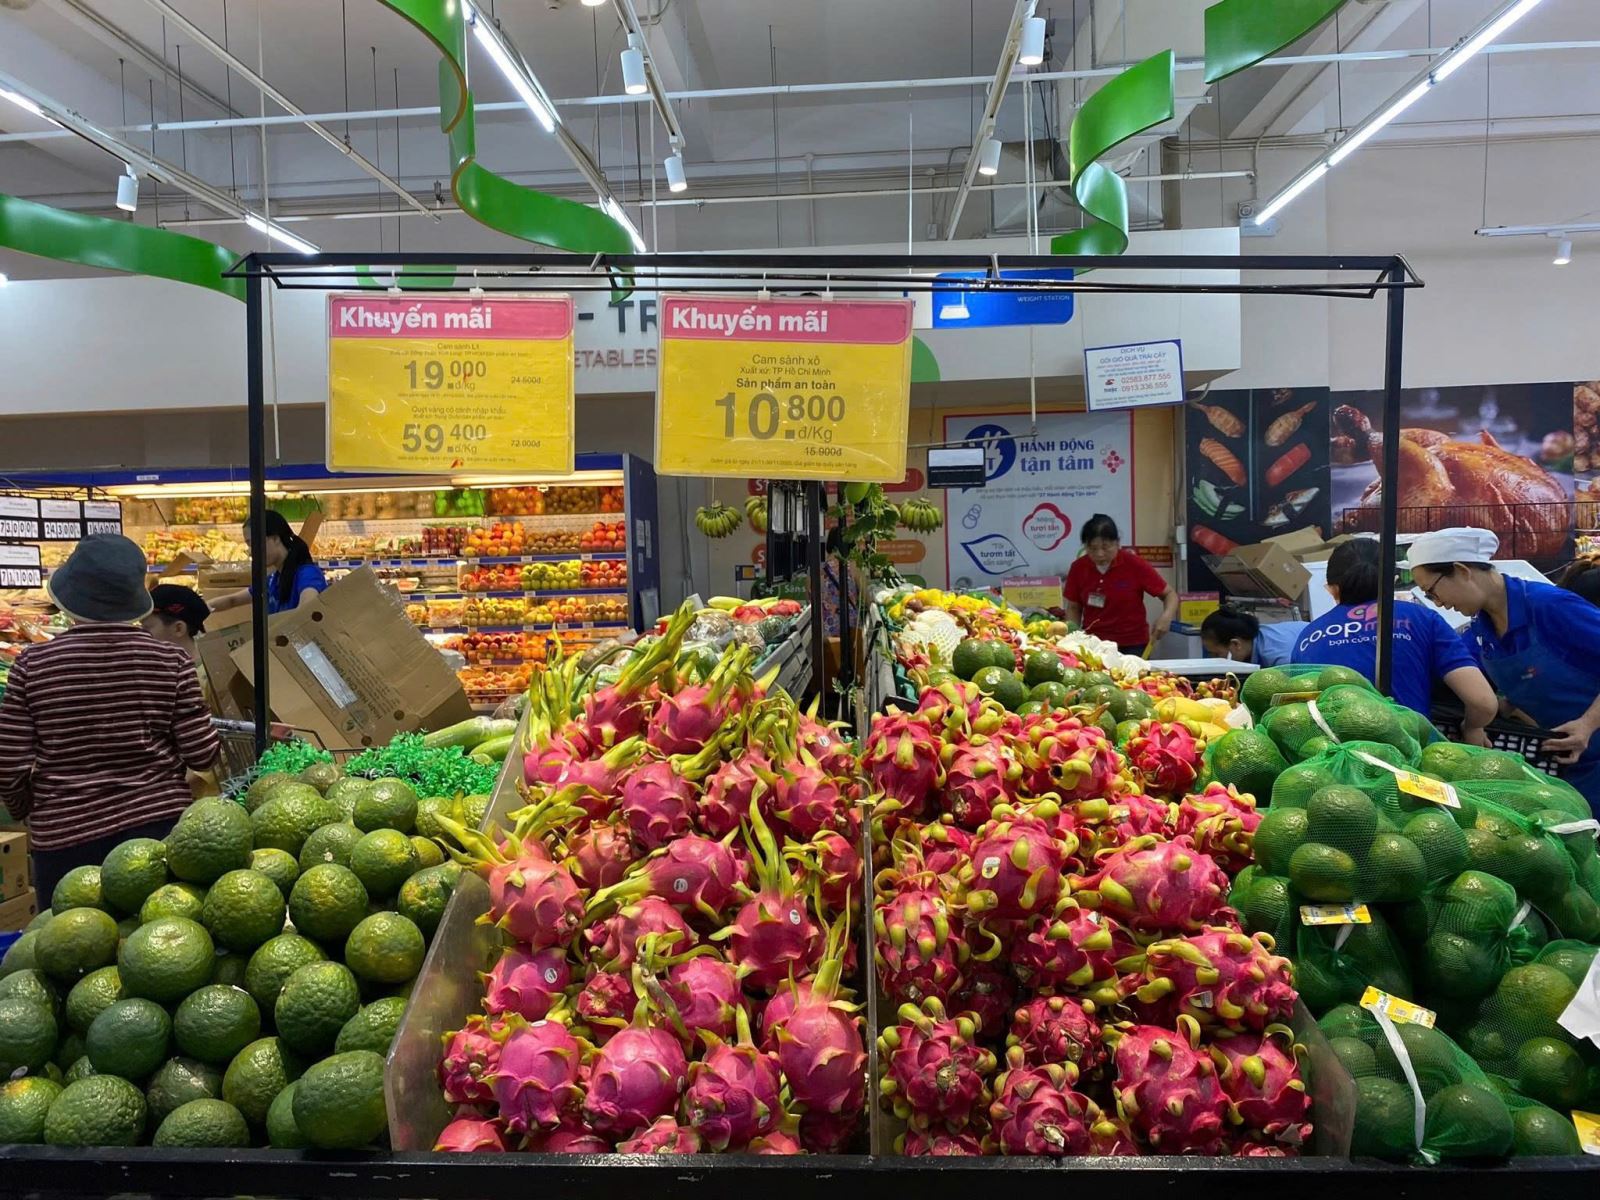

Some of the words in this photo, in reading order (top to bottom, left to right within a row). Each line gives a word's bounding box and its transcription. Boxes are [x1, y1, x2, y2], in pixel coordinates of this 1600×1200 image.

[1043, 294, 1070, 302] STATION
[340, 303, 438, 334] Khuyến
[444, 307, 492, 329] mãi
[672, 305, 772, 336] Khuyến
[778, 310, 828, 332] mãi
[752, 353, 777, 365] Cam
[812, 368, 831, 376] Minh
[736, 377, 758, 388] Sản
[760, 376, 791, 391] phẩm
[794, 381, 808, 390] an
[811, 379, 836, 390] toàn
[1020, 439, 1055, 452] HÀNH
[1060, 438, 1095, 453] ĐỘNG
[1020, 456, 1051, 475] tận
[1058, 455, 1095, 471] tâm
